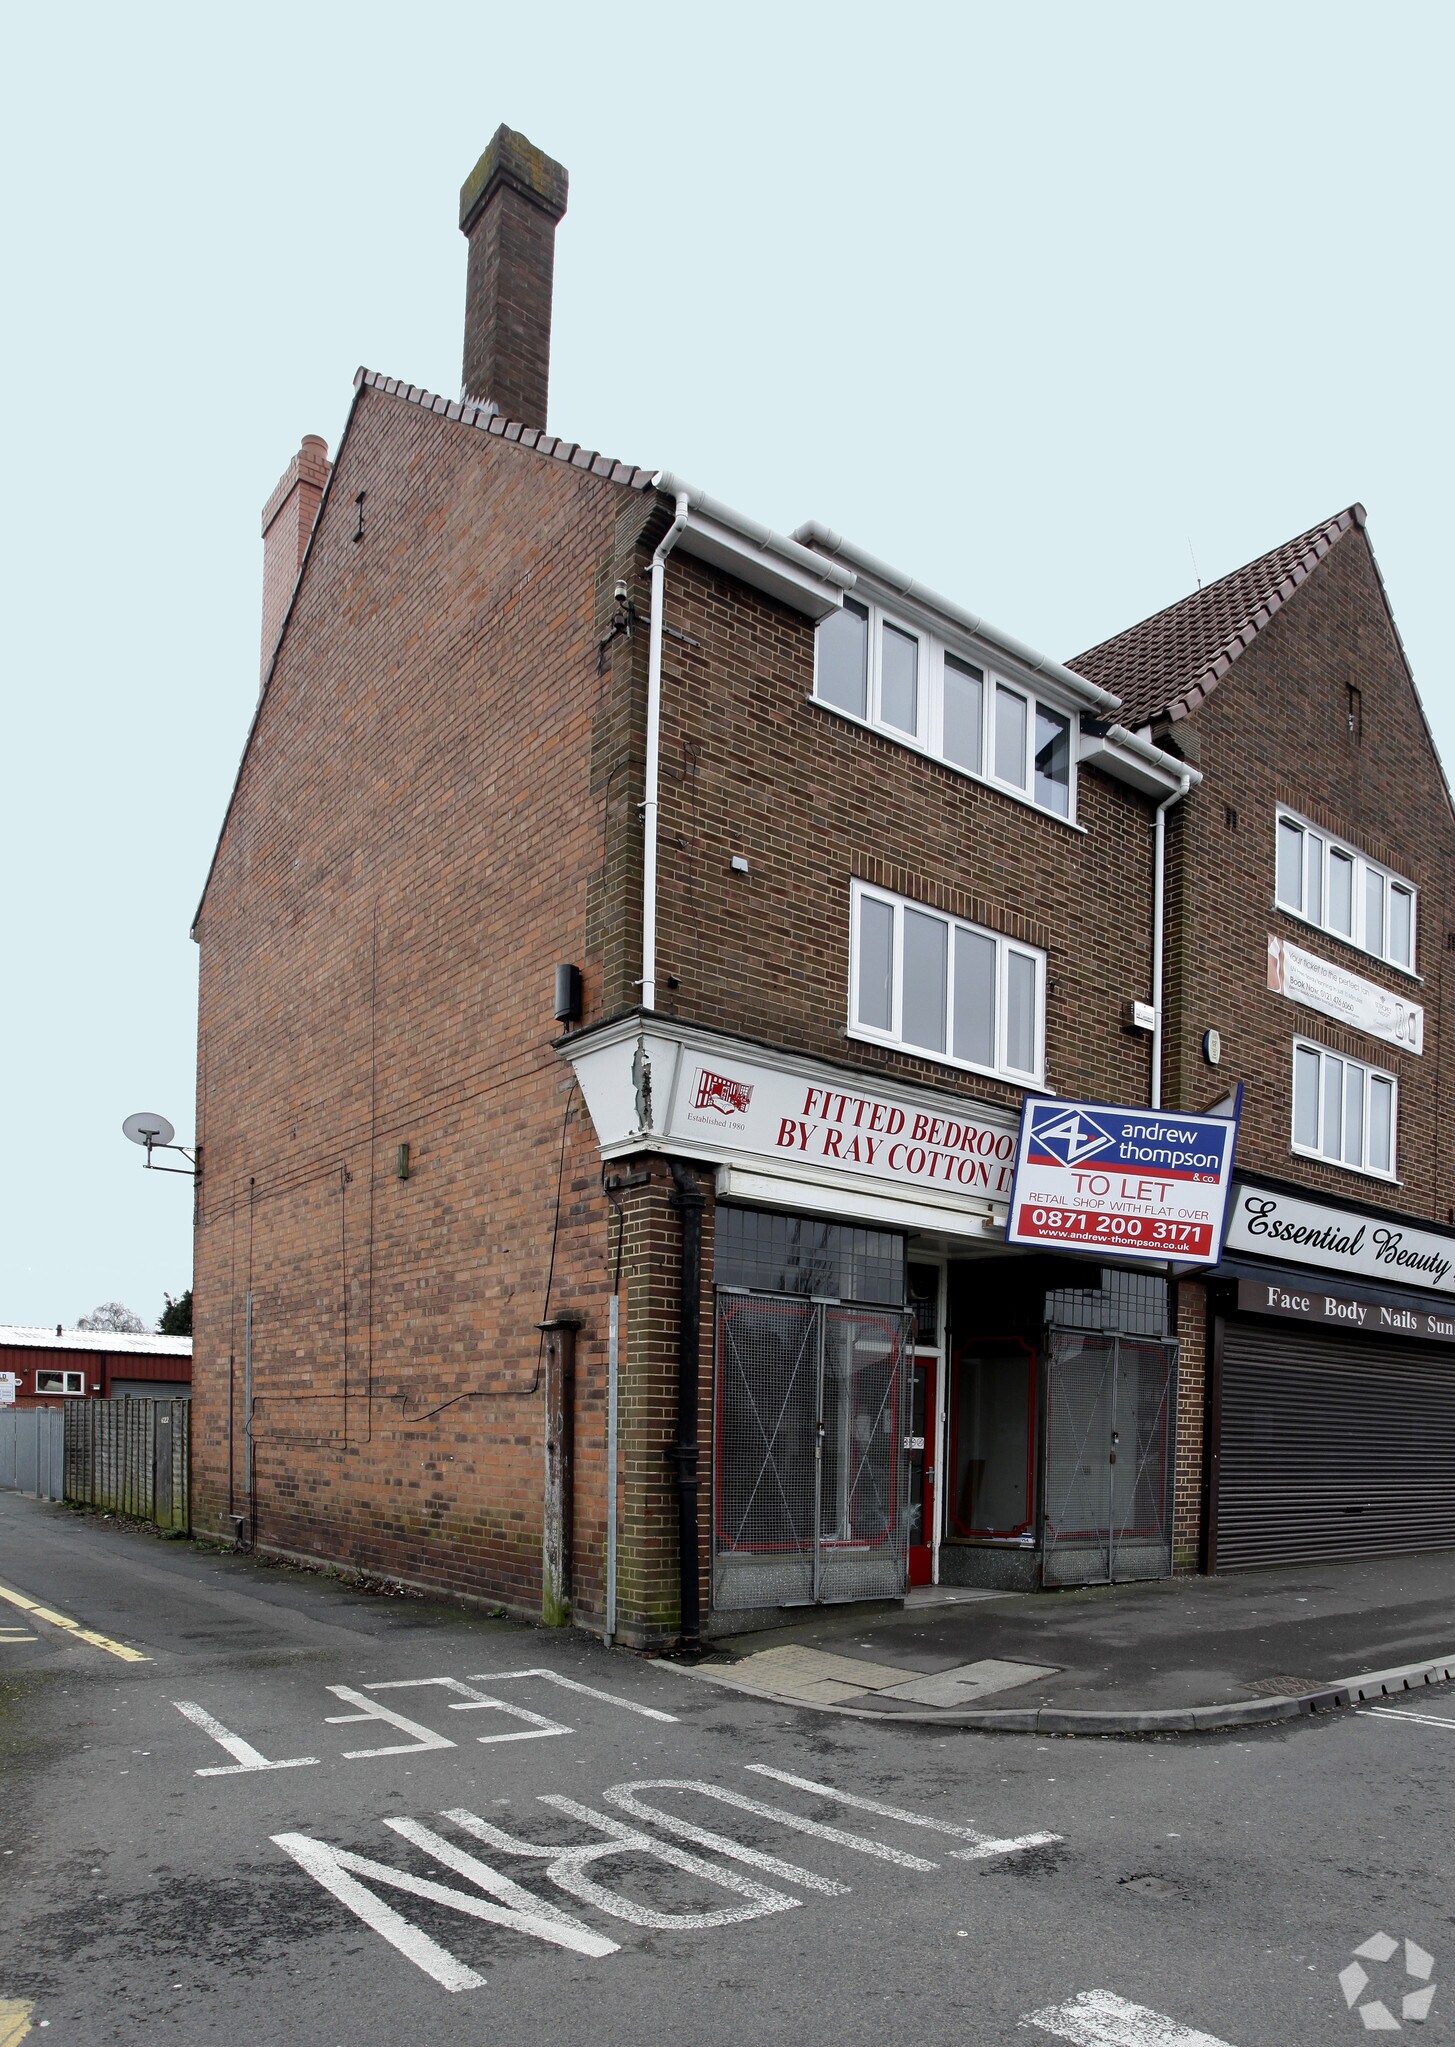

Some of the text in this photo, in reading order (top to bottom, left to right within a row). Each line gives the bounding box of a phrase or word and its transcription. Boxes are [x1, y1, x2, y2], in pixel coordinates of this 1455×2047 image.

[1290, 976, 1305, 989] Book
[1320, 989, 1332, 1001] 0121
[1303, 959, 1320, 974] ticket
[1338, 977, 1360, 991] perfect
[687, 1113, 746, 1131] Established 1980
[801, 1087, 905, 1135] FITTED
[1122, 1123, 1198, 1144] andrew
[775, 1118, 817, 1151] BY
[821, 1128, 884, 1165] RAY
[888, 1145, 993, 1188] COTTON
[1120, 1142, 1218, 1168] thompson
[1071, 1173, 1174, 1202] TO LET
[1193, 1173, 1202, 1183] &
[1029, 1193, 1208, 1220] RETAIL SHOP WITH FLAT OVER
[1033, 1210, 1200, 1242] 0871 200 3171
[1039, 1229, 1190, 1250] www.andrew-thompson.co.uk
[1245, 1197, 1452, 1285] Essential Beauty
[1267, 1287, 1309, 1311] Face
[1325, 1297, 1367, 1325] Body
[1380, 1307, 1417, 1329] Nails
[173, 1669, 678, 1776] LEFT
[269, 1764, 1064, 1991] TURN
